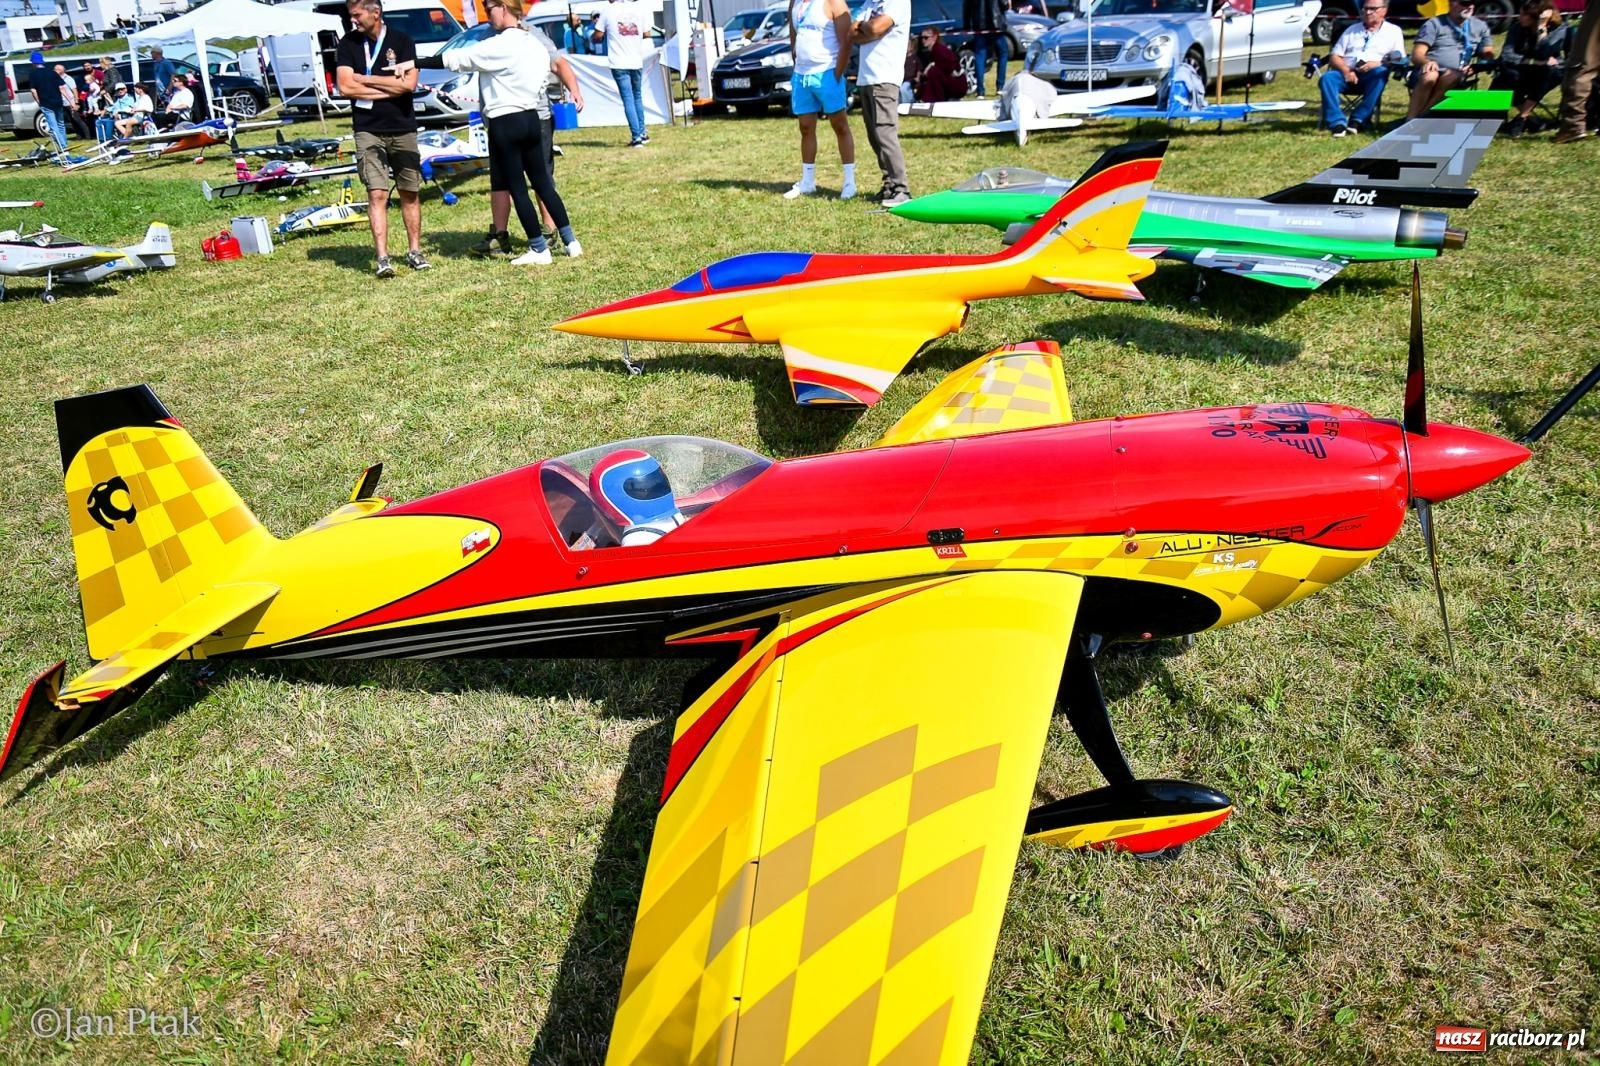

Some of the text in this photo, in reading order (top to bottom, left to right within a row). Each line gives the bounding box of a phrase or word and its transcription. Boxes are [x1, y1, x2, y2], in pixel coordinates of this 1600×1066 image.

[1332, 187, 1378, 206] Pilot
[936, 546, 964, 556] KRILL
[1212, 551, 1235, 564] KS
